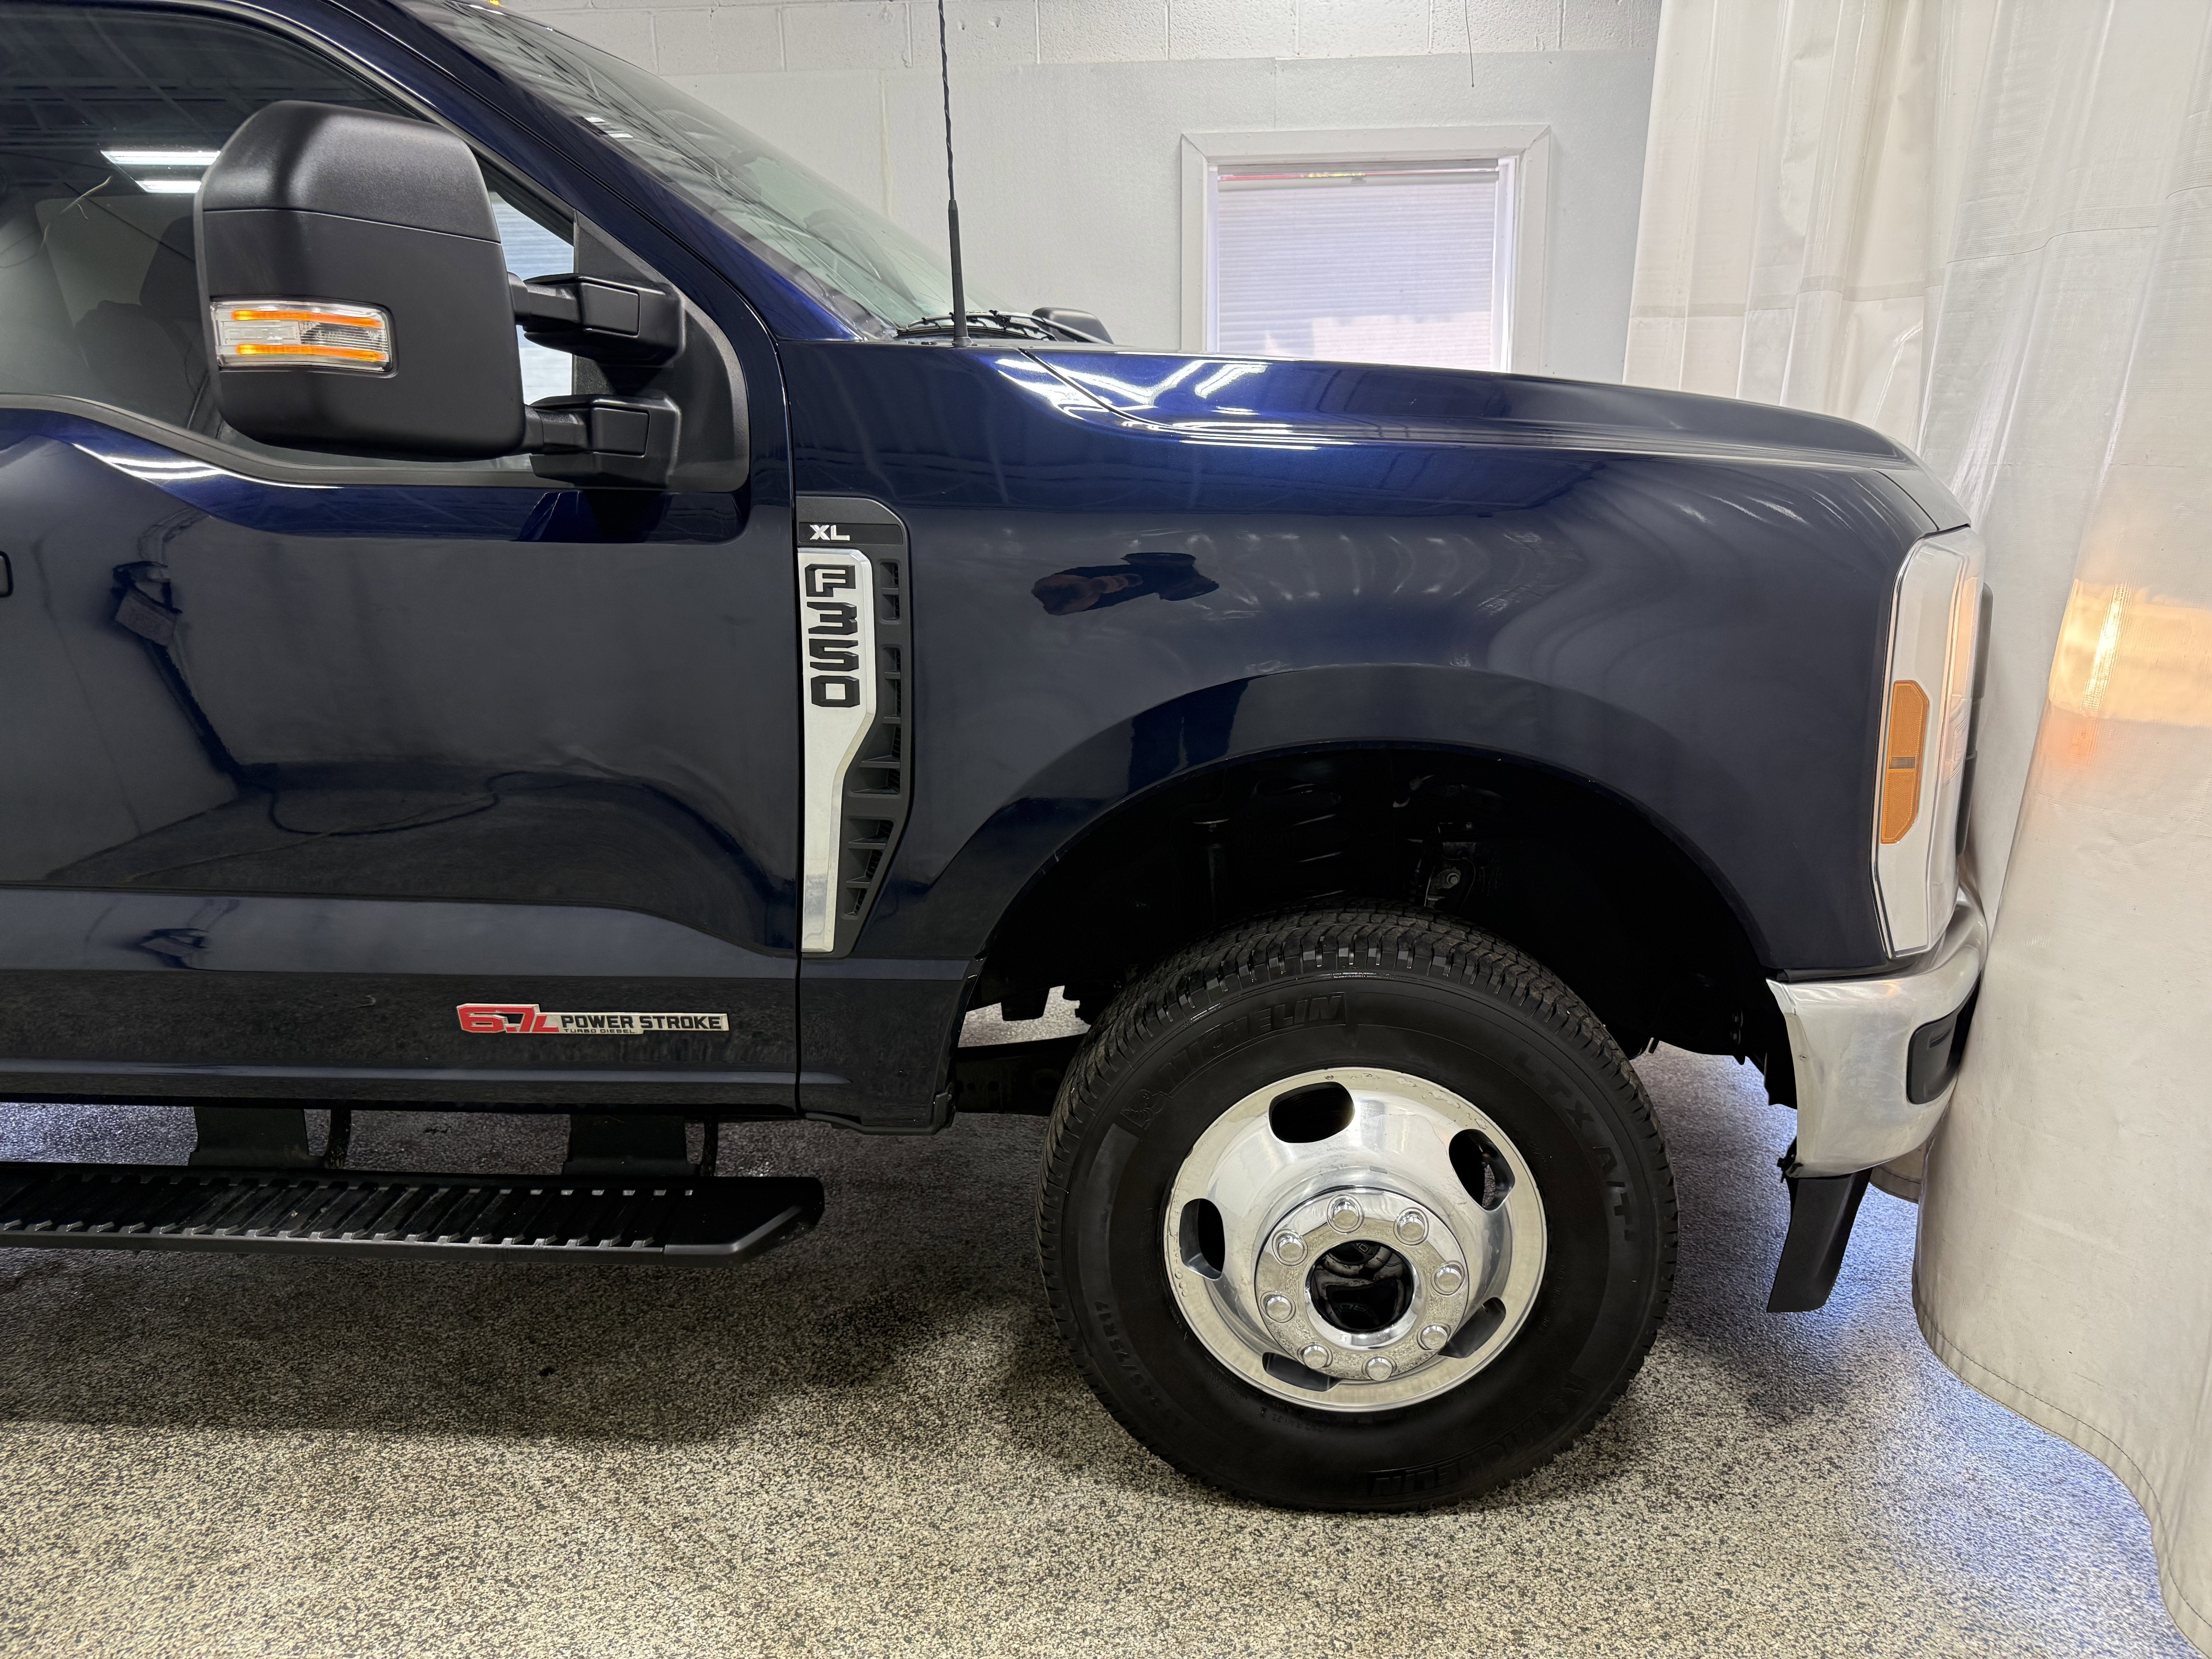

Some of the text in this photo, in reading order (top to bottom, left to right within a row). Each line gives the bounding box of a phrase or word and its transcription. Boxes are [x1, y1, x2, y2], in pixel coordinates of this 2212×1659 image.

[809, 524, 850, 541] XL
[805, 563, 860, 708] F350
[457, 1003, 722, 1033] 6.7L POWER STROKE
[1157, 994, 1343, 1087] MICHELIN
